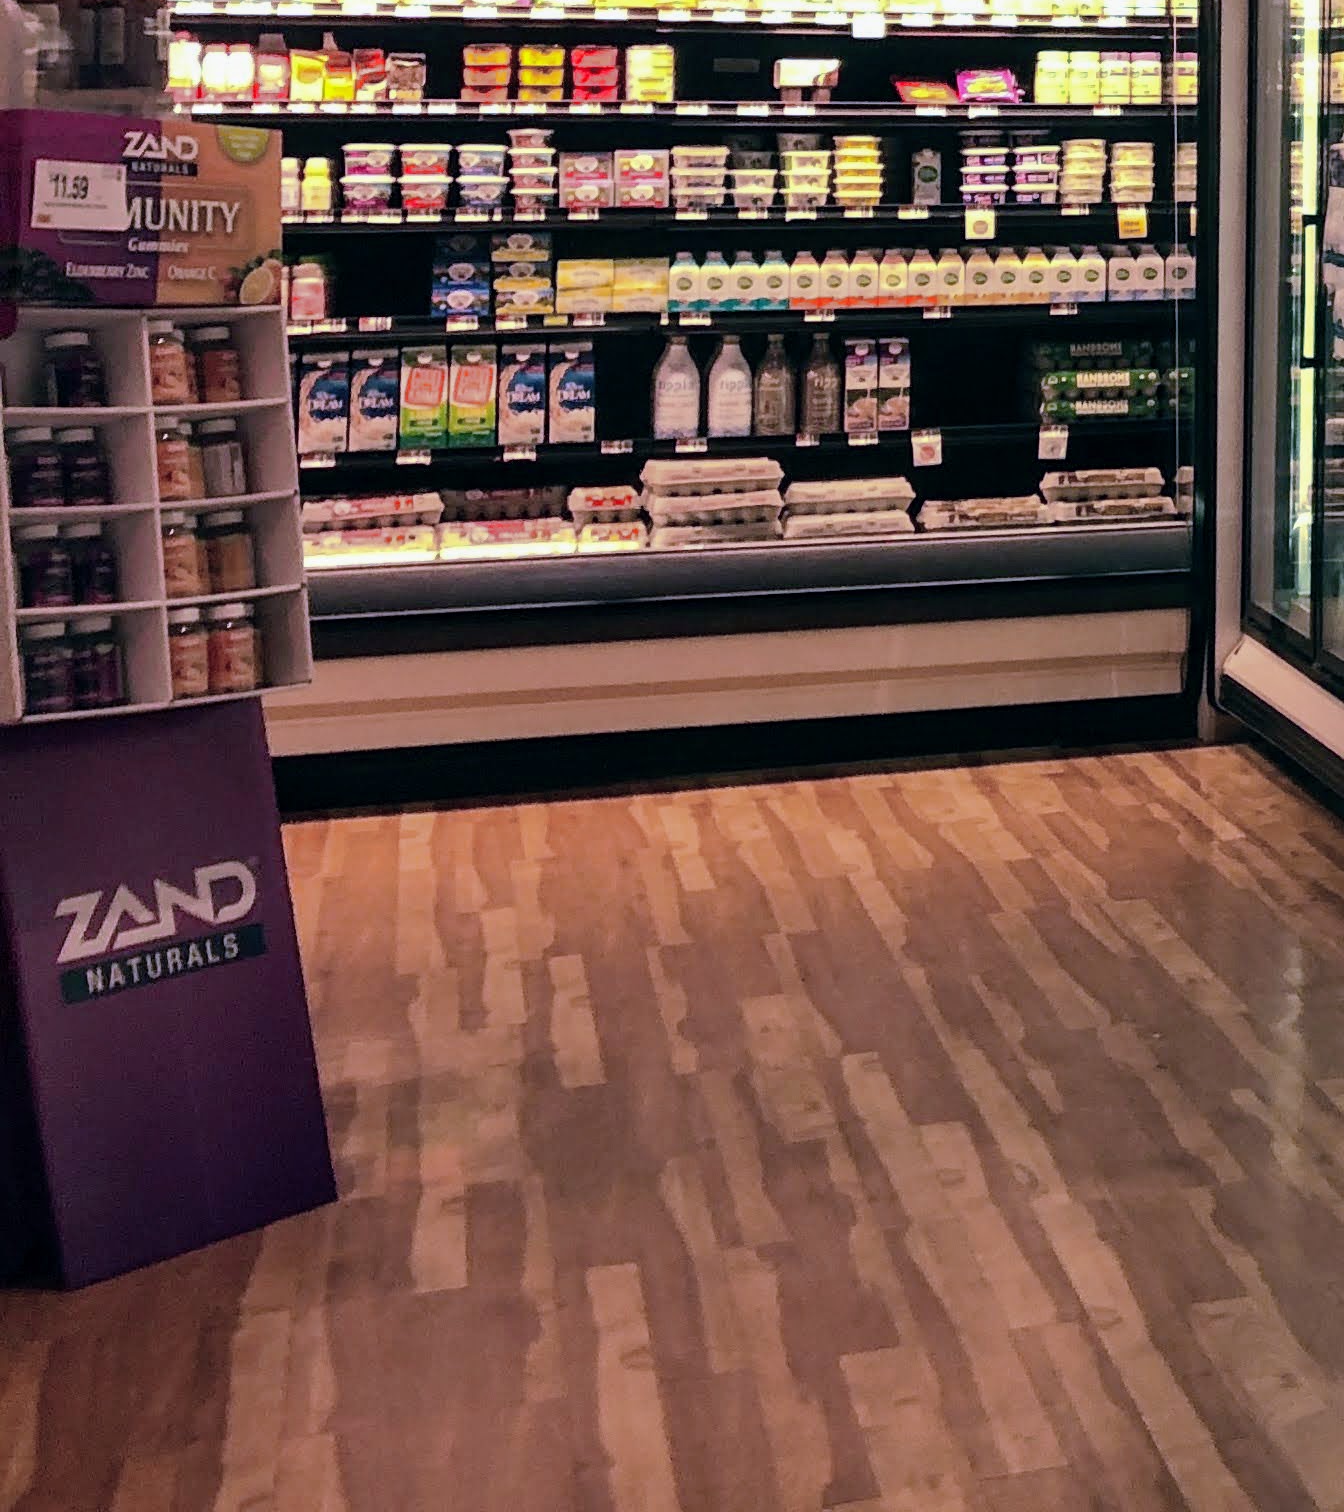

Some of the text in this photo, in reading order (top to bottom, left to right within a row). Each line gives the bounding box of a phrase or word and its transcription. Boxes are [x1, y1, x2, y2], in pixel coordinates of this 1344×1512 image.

[122, 131, 199, 160] ZAND
[127, 196, 241, 234] MUNITY
[53, 860, 256, 964] ZAND
[86, 933, 240, 994] NATURALS
